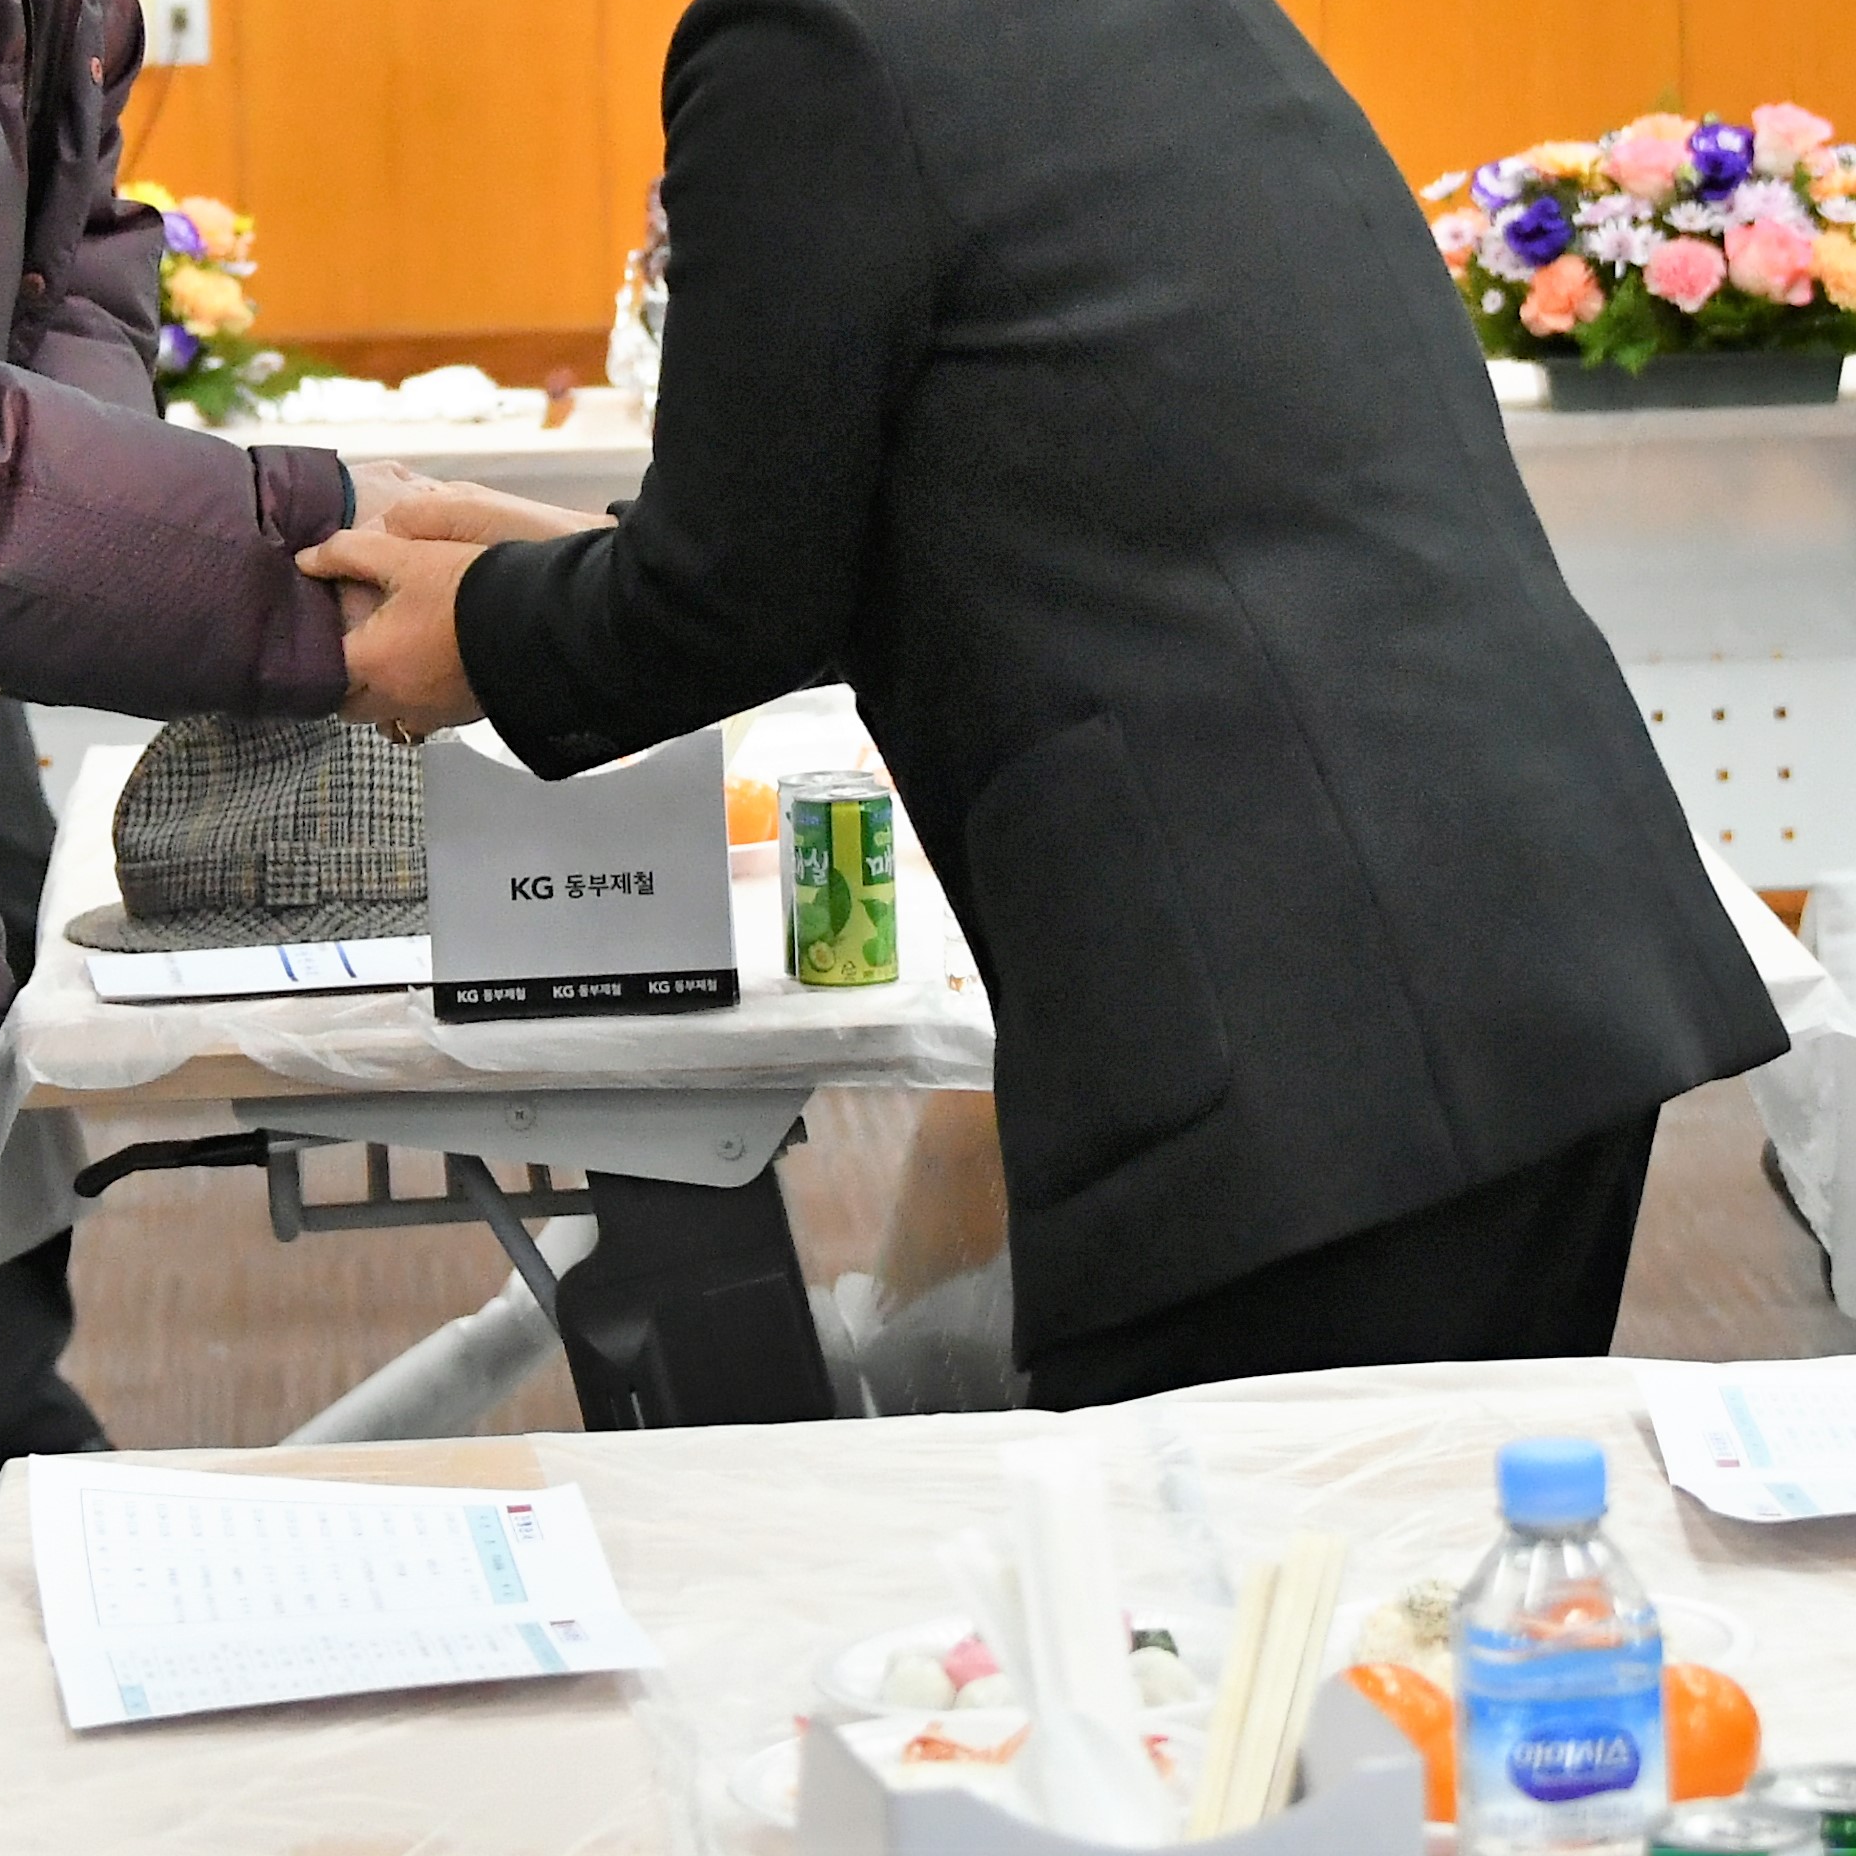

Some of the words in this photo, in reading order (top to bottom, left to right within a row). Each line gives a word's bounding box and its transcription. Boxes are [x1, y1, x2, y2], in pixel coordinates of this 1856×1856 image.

[510, 875, 554, 901] KG
[564, 870, 655, 899] 동부제철
[456, 989, 479, 1003] KG
[552, 985, 575, 999] KG
[648, 980, 671, 994] KG
